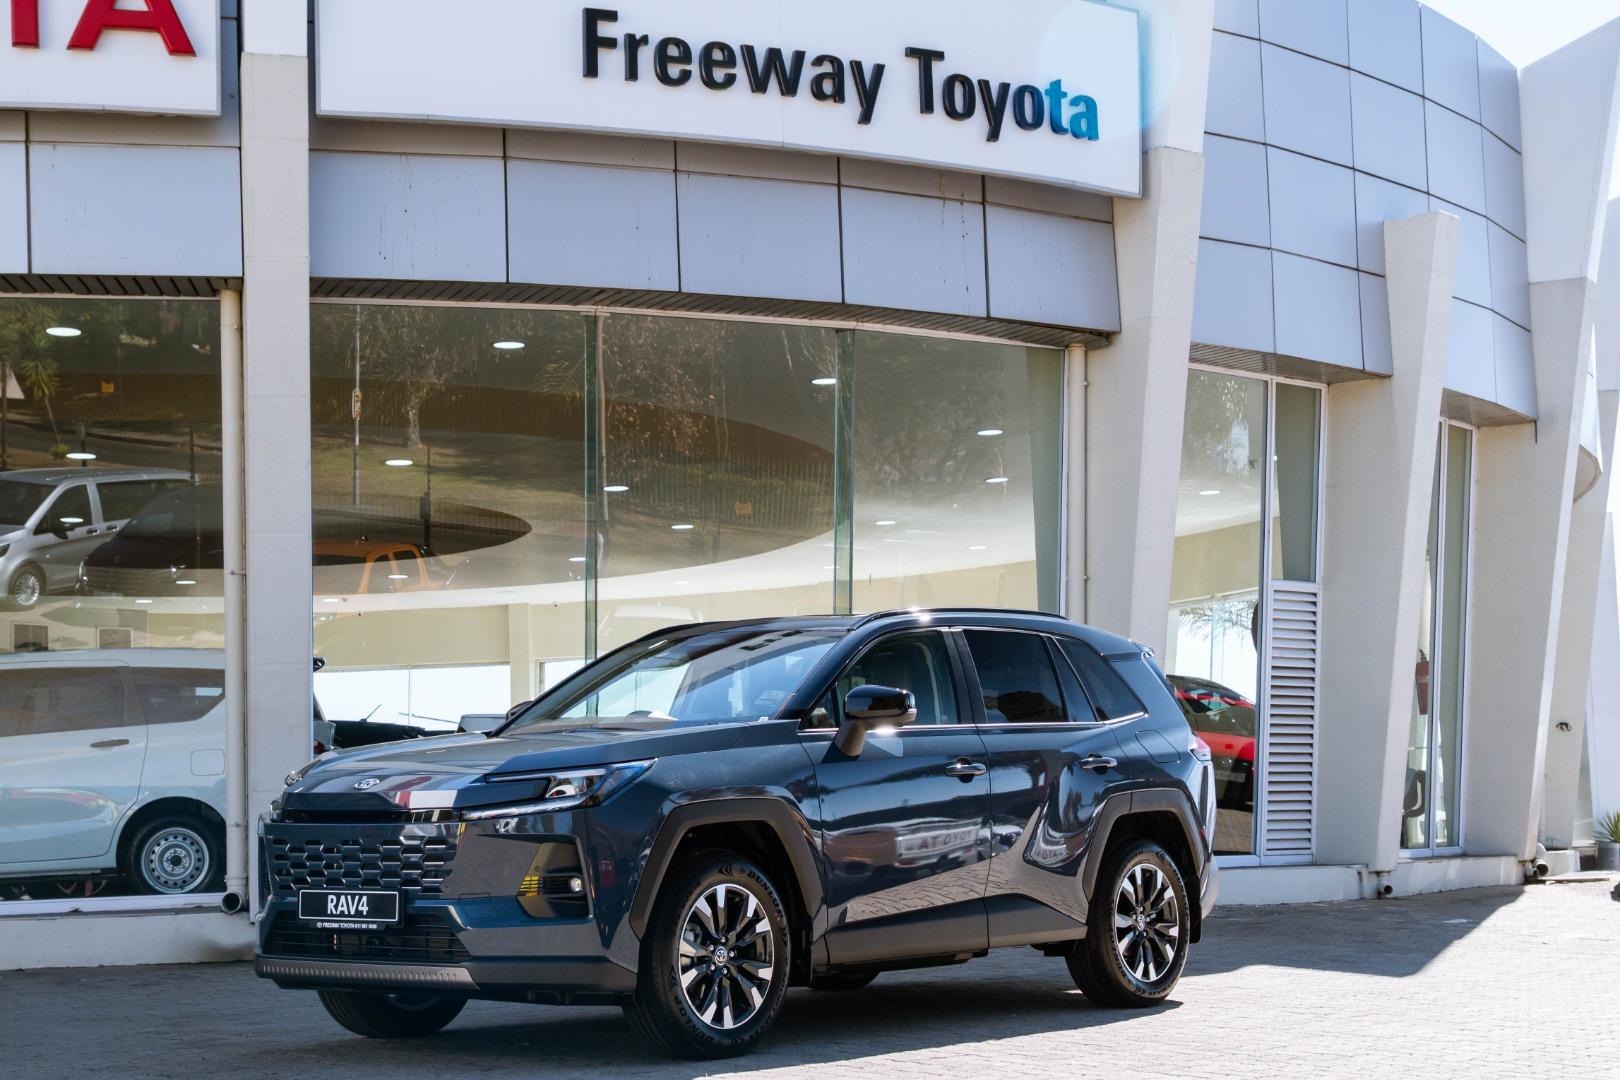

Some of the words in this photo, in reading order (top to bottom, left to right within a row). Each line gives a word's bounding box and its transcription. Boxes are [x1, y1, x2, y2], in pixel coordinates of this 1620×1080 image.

[582, 7, 886, 125] Freeway
[905, 46, 1099, 142] Toyota
[327, 894, 369, 915] RAV4
[747, 868, 784, 919] DUNLOP
